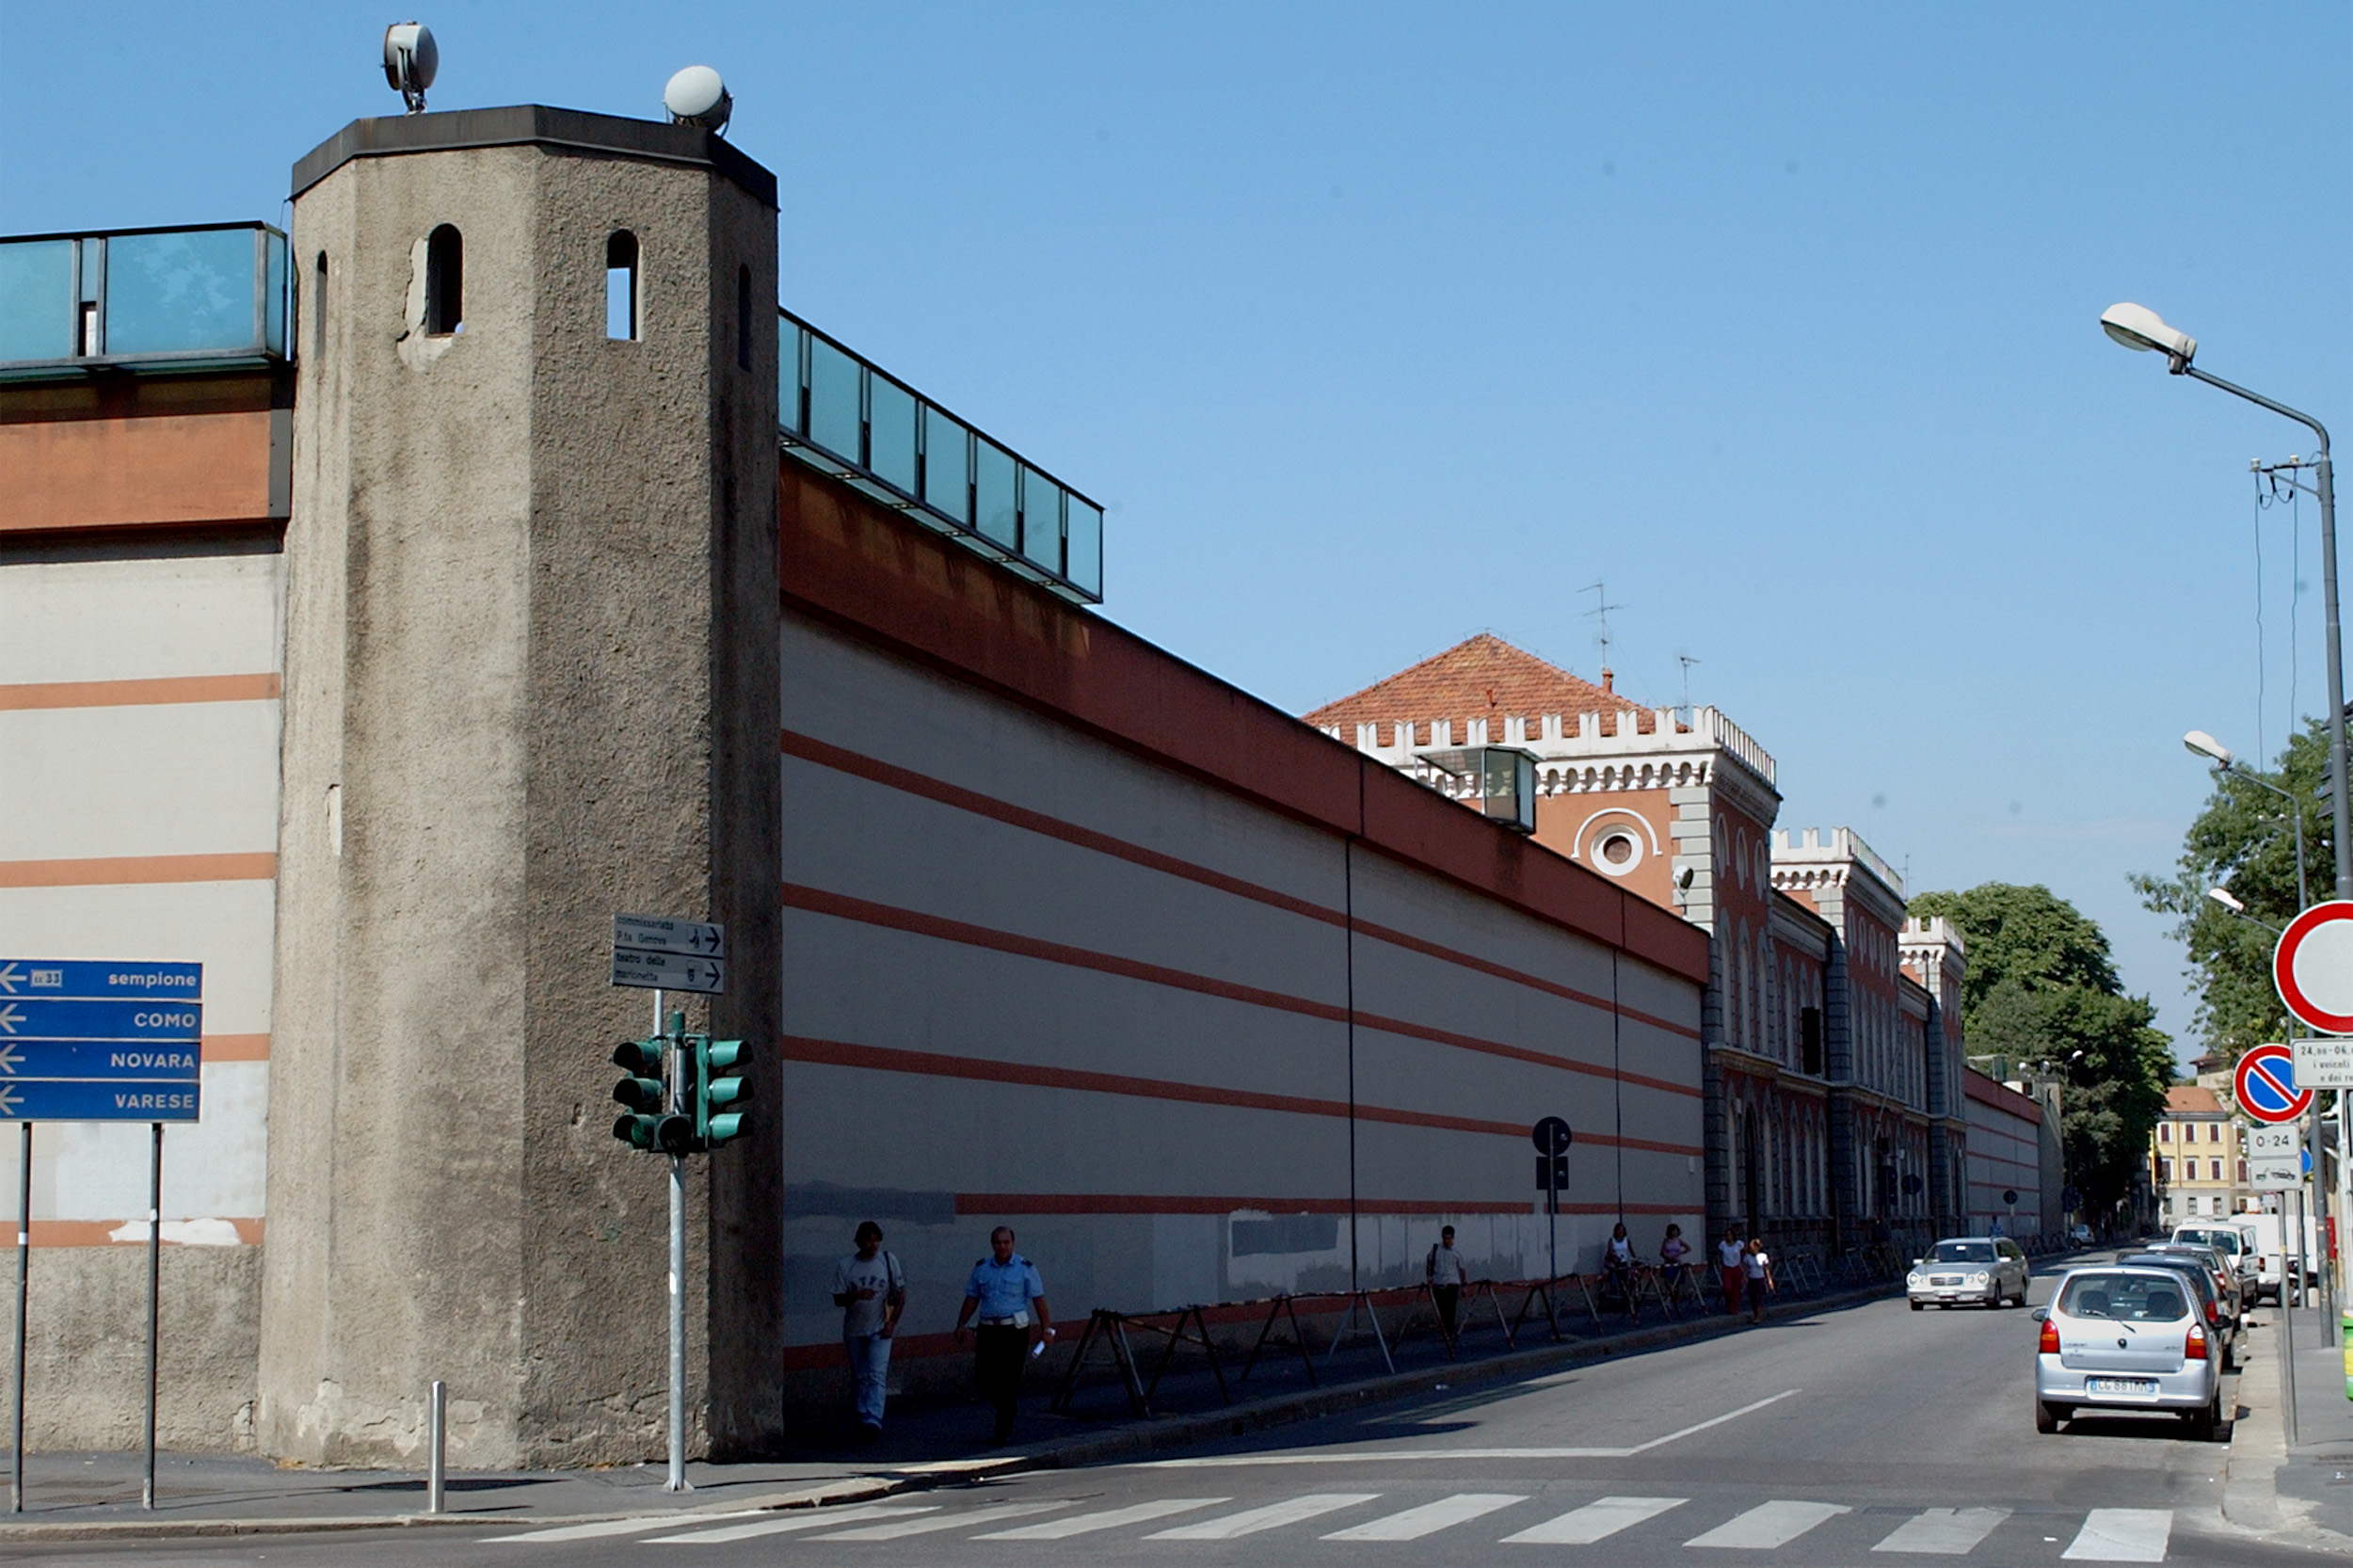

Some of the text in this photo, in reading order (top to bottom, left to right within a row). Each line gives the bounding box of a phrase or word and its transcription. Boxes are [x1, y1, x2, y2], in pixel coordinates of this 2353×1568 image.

[108, 971, 197, 988] sempione
[134, 1013, 197, 1028] COMO
[110, 1052, 195, 1068] NOVARA
[115, 1094, 195, 1109] VARESE
